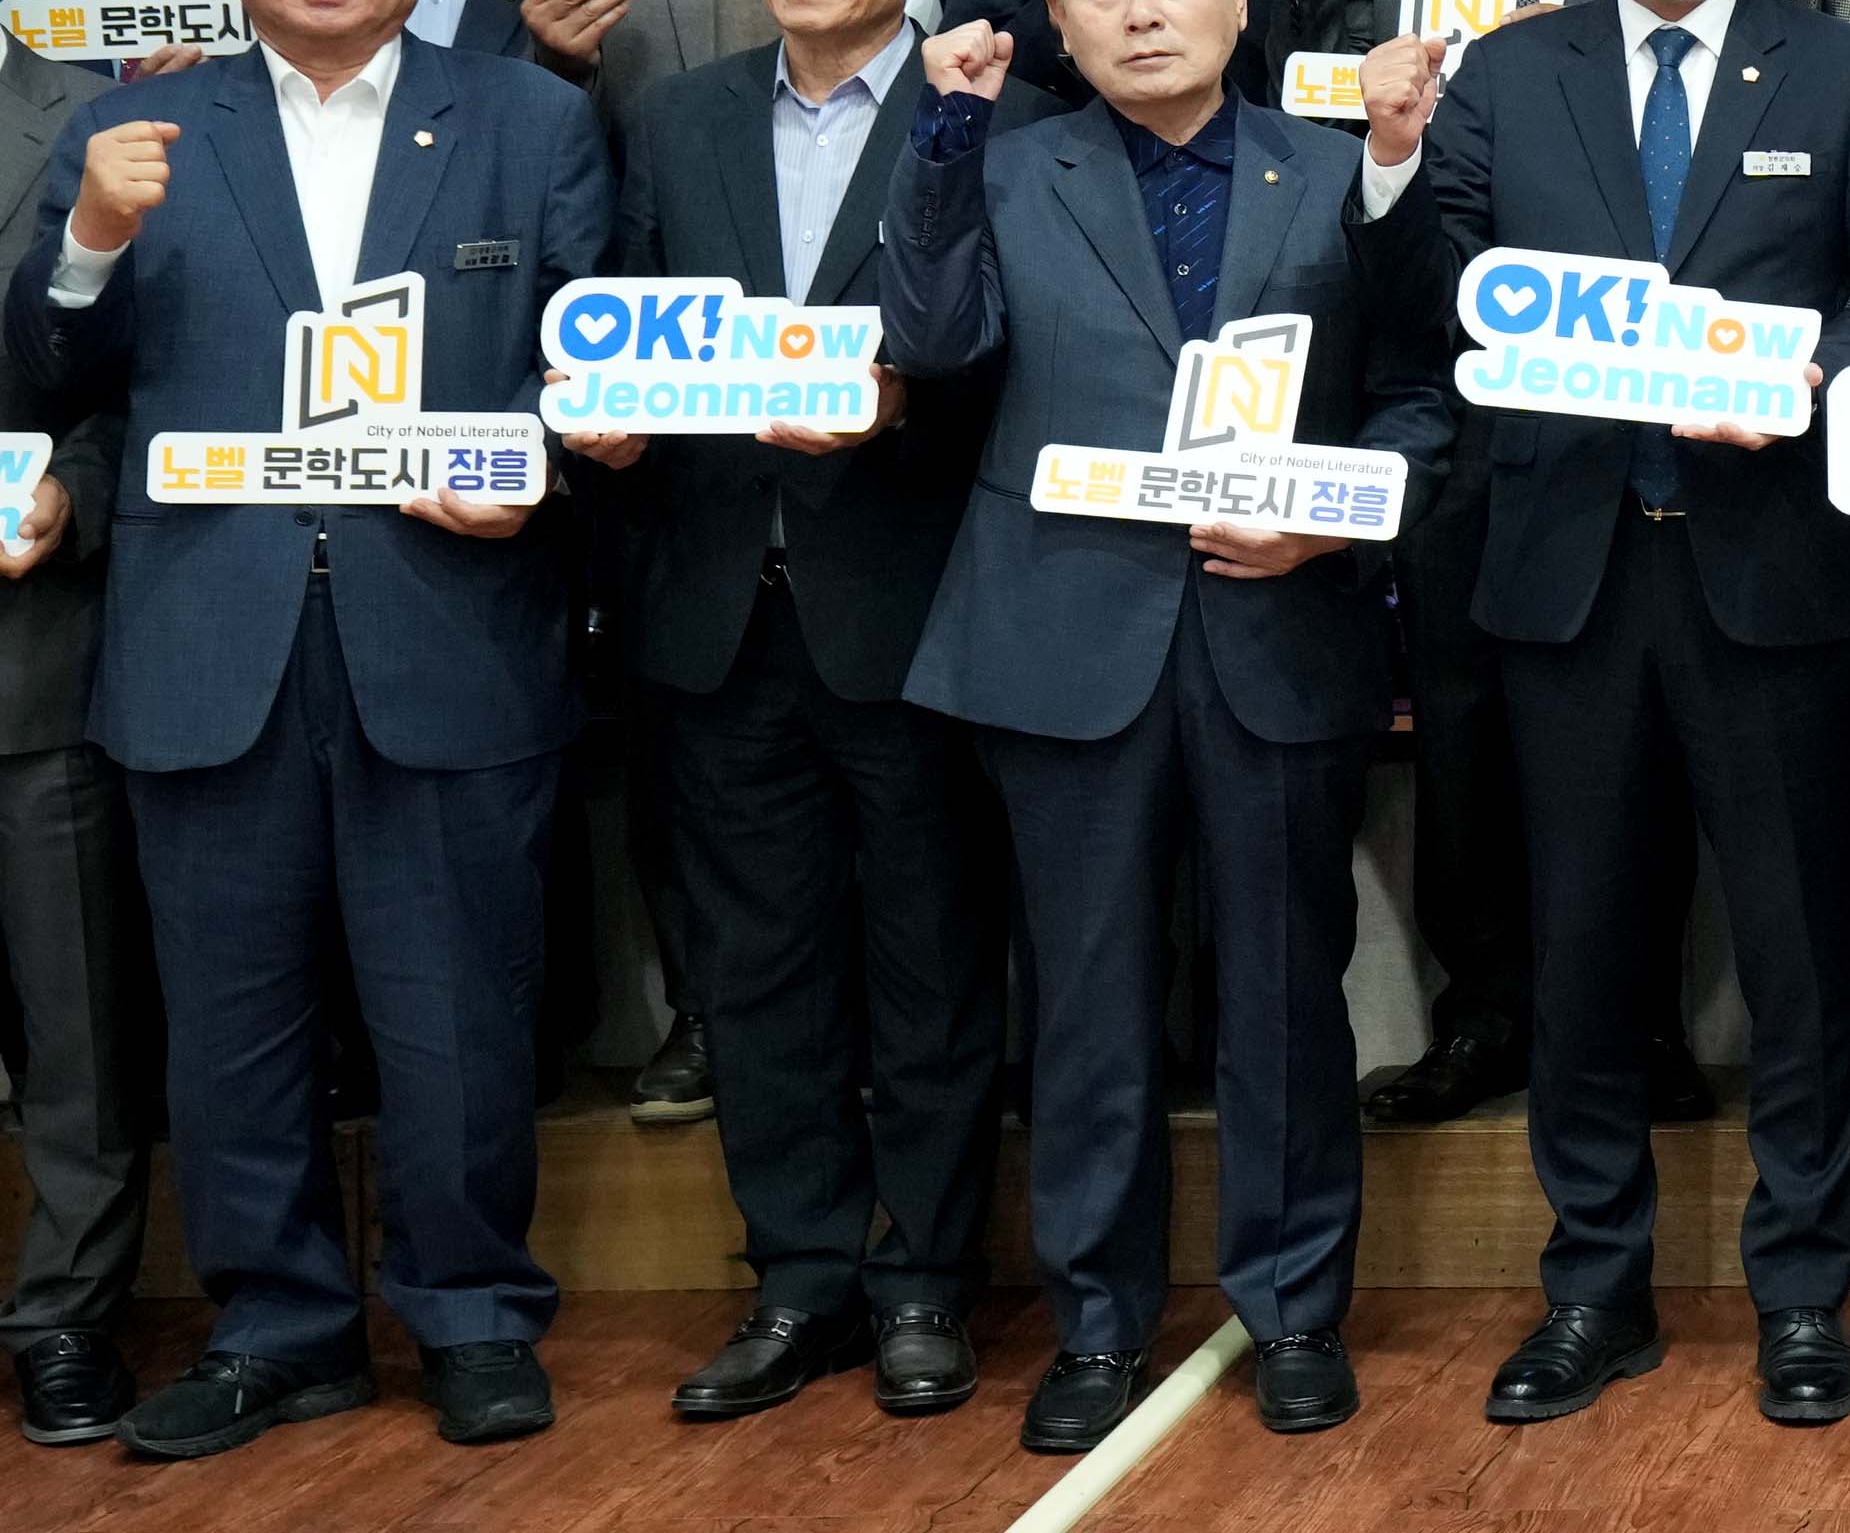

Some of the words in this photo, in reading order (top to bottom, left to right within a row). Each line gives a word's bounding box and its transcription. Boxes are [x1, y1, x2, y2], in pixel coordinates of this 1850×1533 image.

[11, 8, 87, 48] 노벨
[101, 4, 251, 45] 문학도시
[559, 293, 725, 362] OK!
[731, 315, 868, 359] Now
[1476, 264, 1651, 347] OK!
[1656, 302, 1802, 359] Now
[558, 372, 862, 418] Jeonnam
[1474, 346, 1794, 418] Jeonnam
[367, 425, 394, 439] City
[399, 425, 413, 437] of
[417, 425, 456, 437] Nobel
[460, 426, 528, 438] Literature
[162, 446, 246, 490] 노벨
[263, 447, 430, 490] 문학도시
[448, 449, 528, 491] 장흥
[1241, 453, 1265, 466] City
[1270, 455, 1282, 465] of
[1287, 457, 1324, 469] Nobel
[1328, 460, 1392, 475] Literature
[1046, 458, 1124, 504] 노벨
[1137, 466, 1296, 518] 문학도시
[1309, 481, 1388, 526] 장흥
